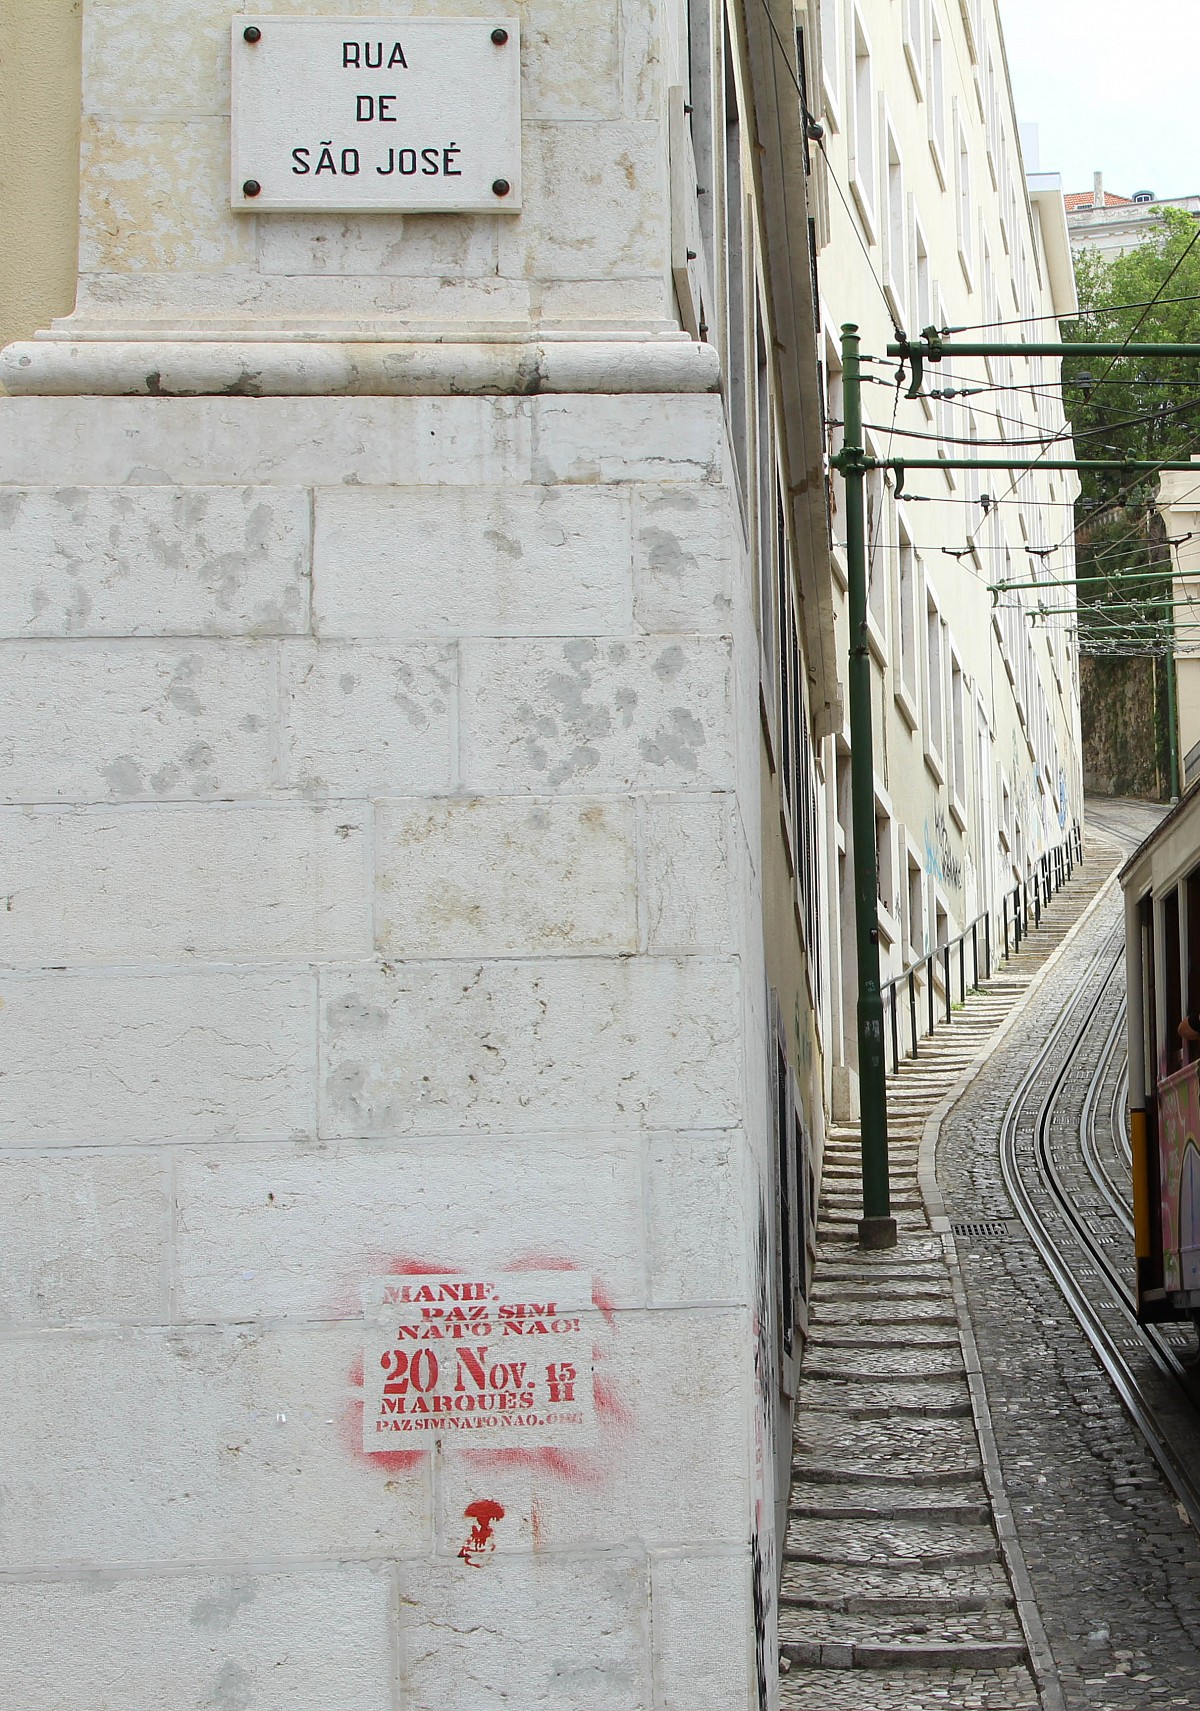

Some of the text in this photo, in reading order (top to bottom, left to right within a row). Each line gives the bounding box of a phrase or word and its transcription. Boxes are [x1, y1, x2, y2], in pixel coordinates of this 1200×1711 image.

[342, 42, 408, 69] RUA
[355, 95, 398, 122] DE
[292, 140, 462, 176] SÃO JOSÉ
[382, 1282, 500, 1304] MANIF.
[421, 1302, 557, 1323] PAZ SIM
[397, 1322, 492, 1340] NATO
[380, 1348, 439, 1394] 20
[545, 1362, 577, 1383] 15
[380, 1390, 534, 1415] MARQUÊS
